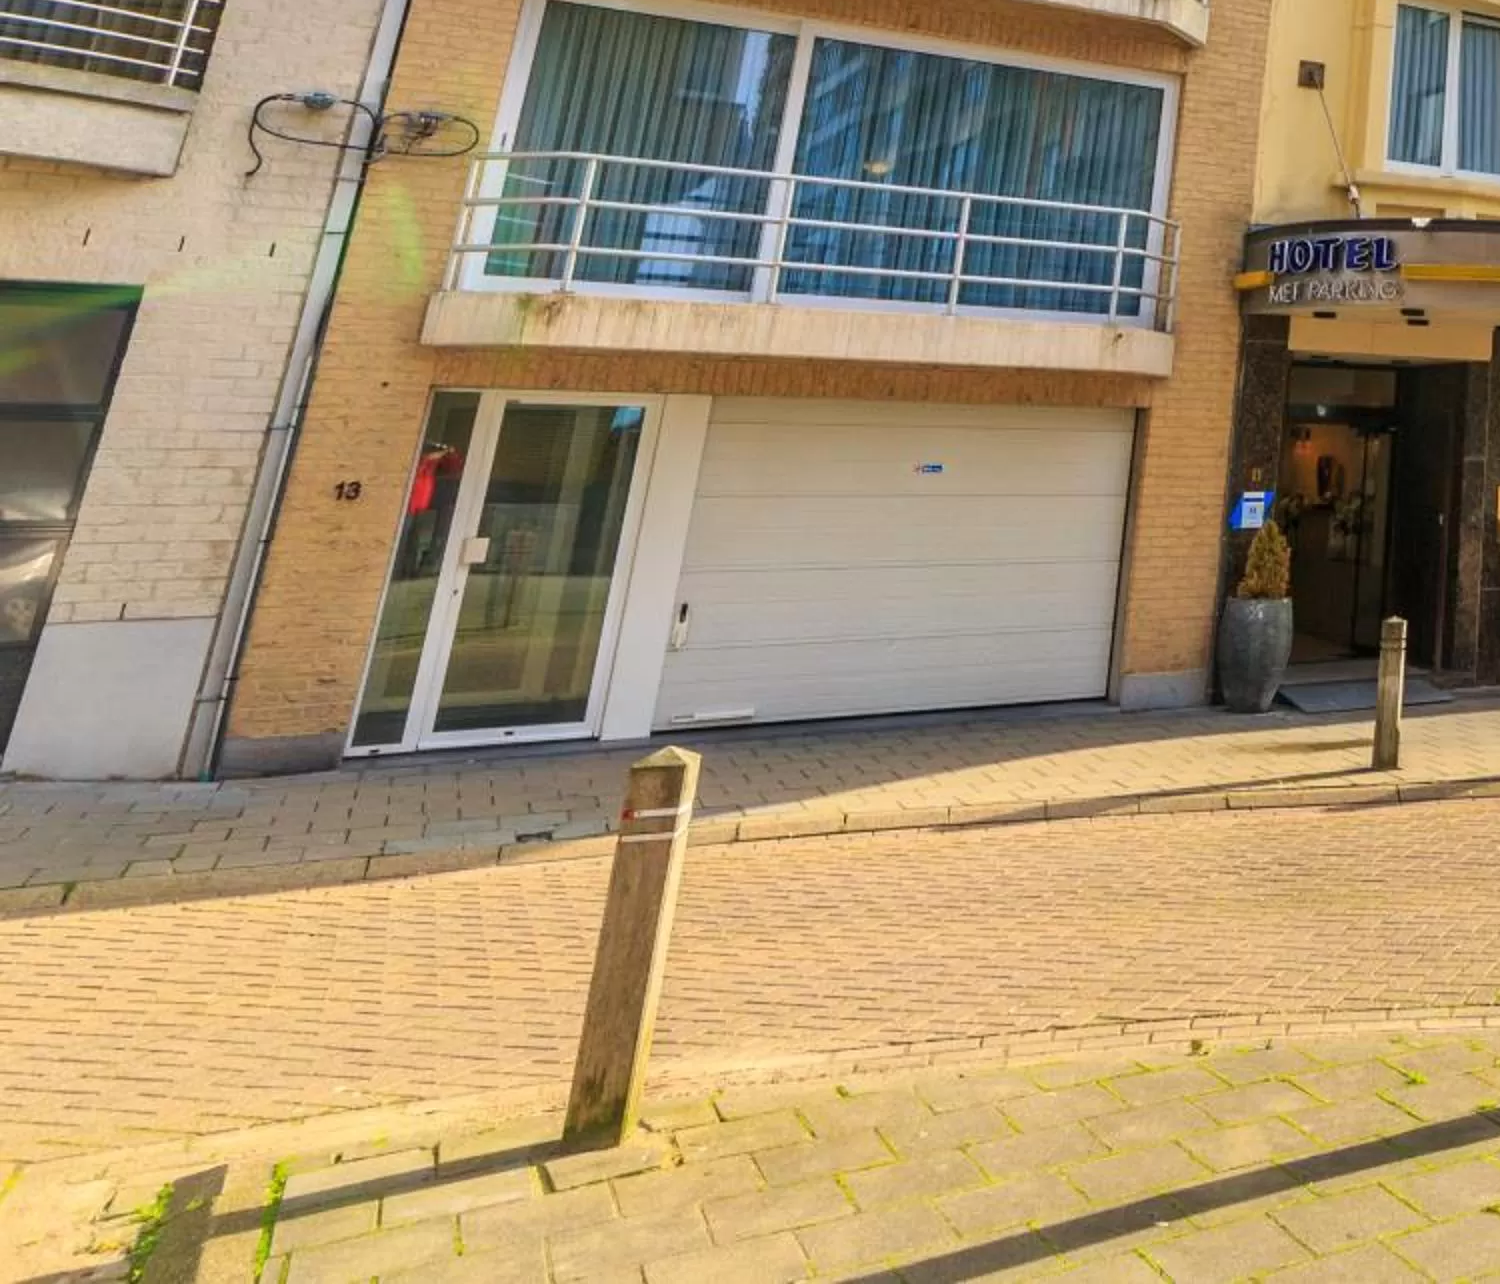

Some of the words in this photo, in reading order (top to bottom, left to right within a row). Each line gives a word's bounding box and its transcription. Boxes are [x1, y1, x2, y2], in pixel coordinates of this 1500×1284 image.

[1267, 235, 1399, 273] HOTEL
[1268, 281, 1300, 304] MET
[1307, 278, 1399, 301] PARKING
[335, 480, 362, 501] 13
